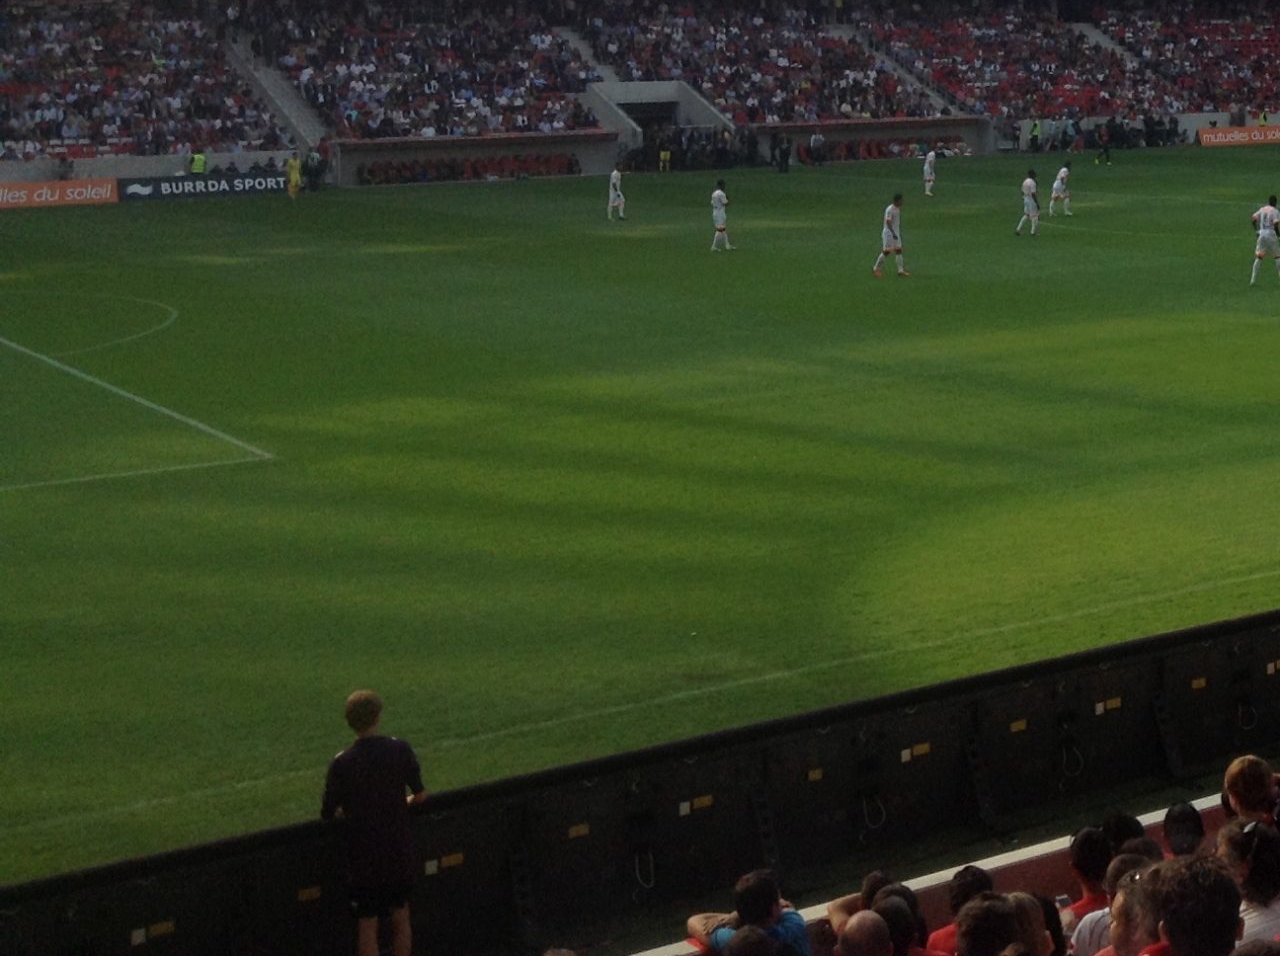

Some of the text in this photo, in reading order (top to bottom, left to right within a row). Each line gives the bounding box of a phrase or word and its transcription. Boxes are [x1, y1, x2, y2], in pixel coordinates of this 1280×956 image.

[1203, 131, 1249, 143] mutuelles
[1251, 129, 1264, 141] du
[33, 186, 60, 201] du
[65, 184, 112, 200] soleil
[161, 177, 286, 195] BURRDA SPORT
